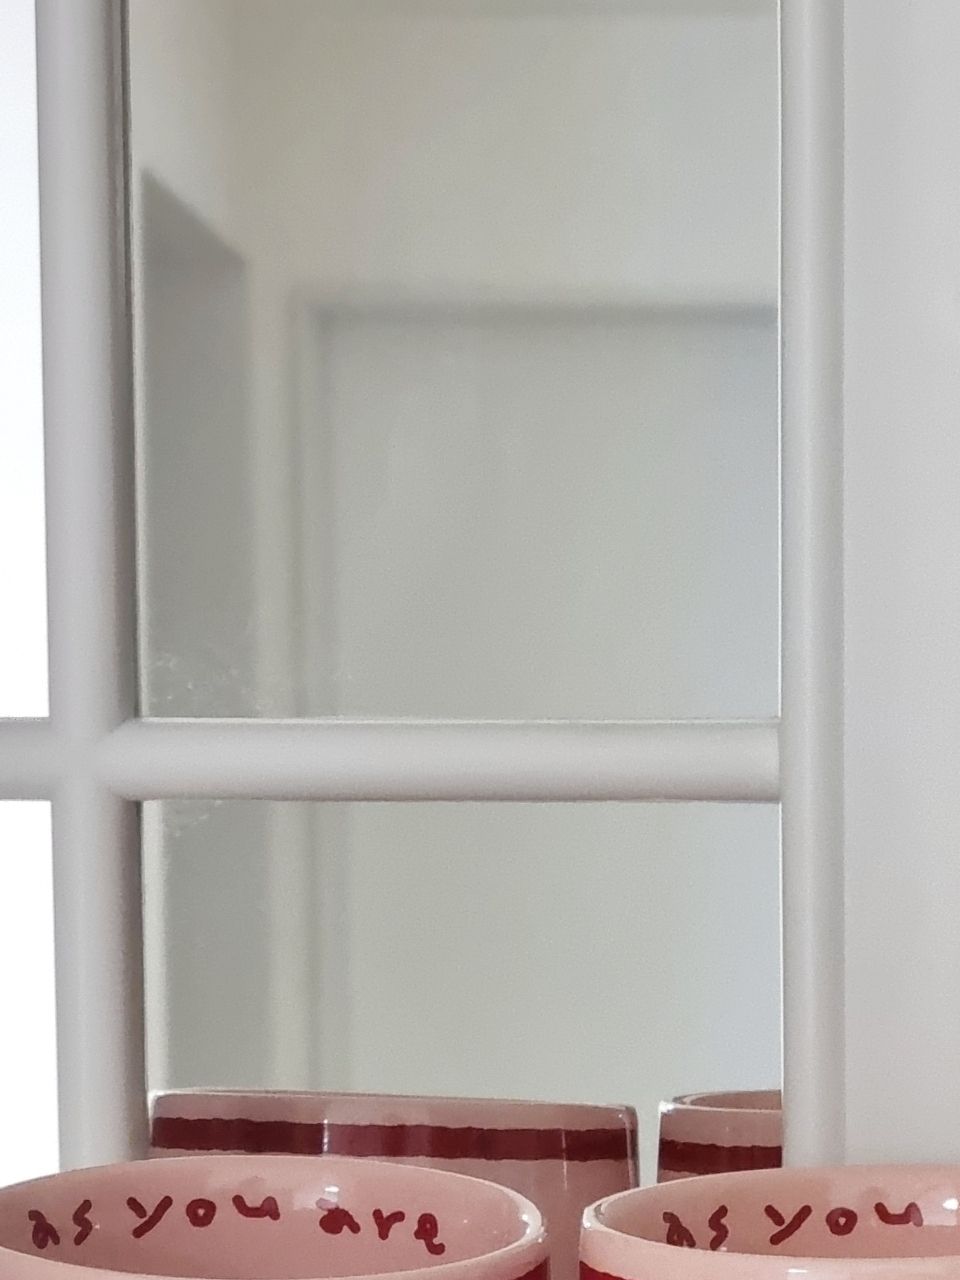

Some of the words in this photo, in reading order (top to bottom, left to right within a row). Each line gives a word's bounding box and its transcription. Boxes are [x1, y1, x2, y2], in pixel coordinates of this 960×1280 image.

[28, 1199, 92, 1249] as
[127, 1194, 281, 1240] you
[315, 1197, 446, 1255] are
[661, 1204, 729, 1251] as
[765, 1200, 923, 1246] you
